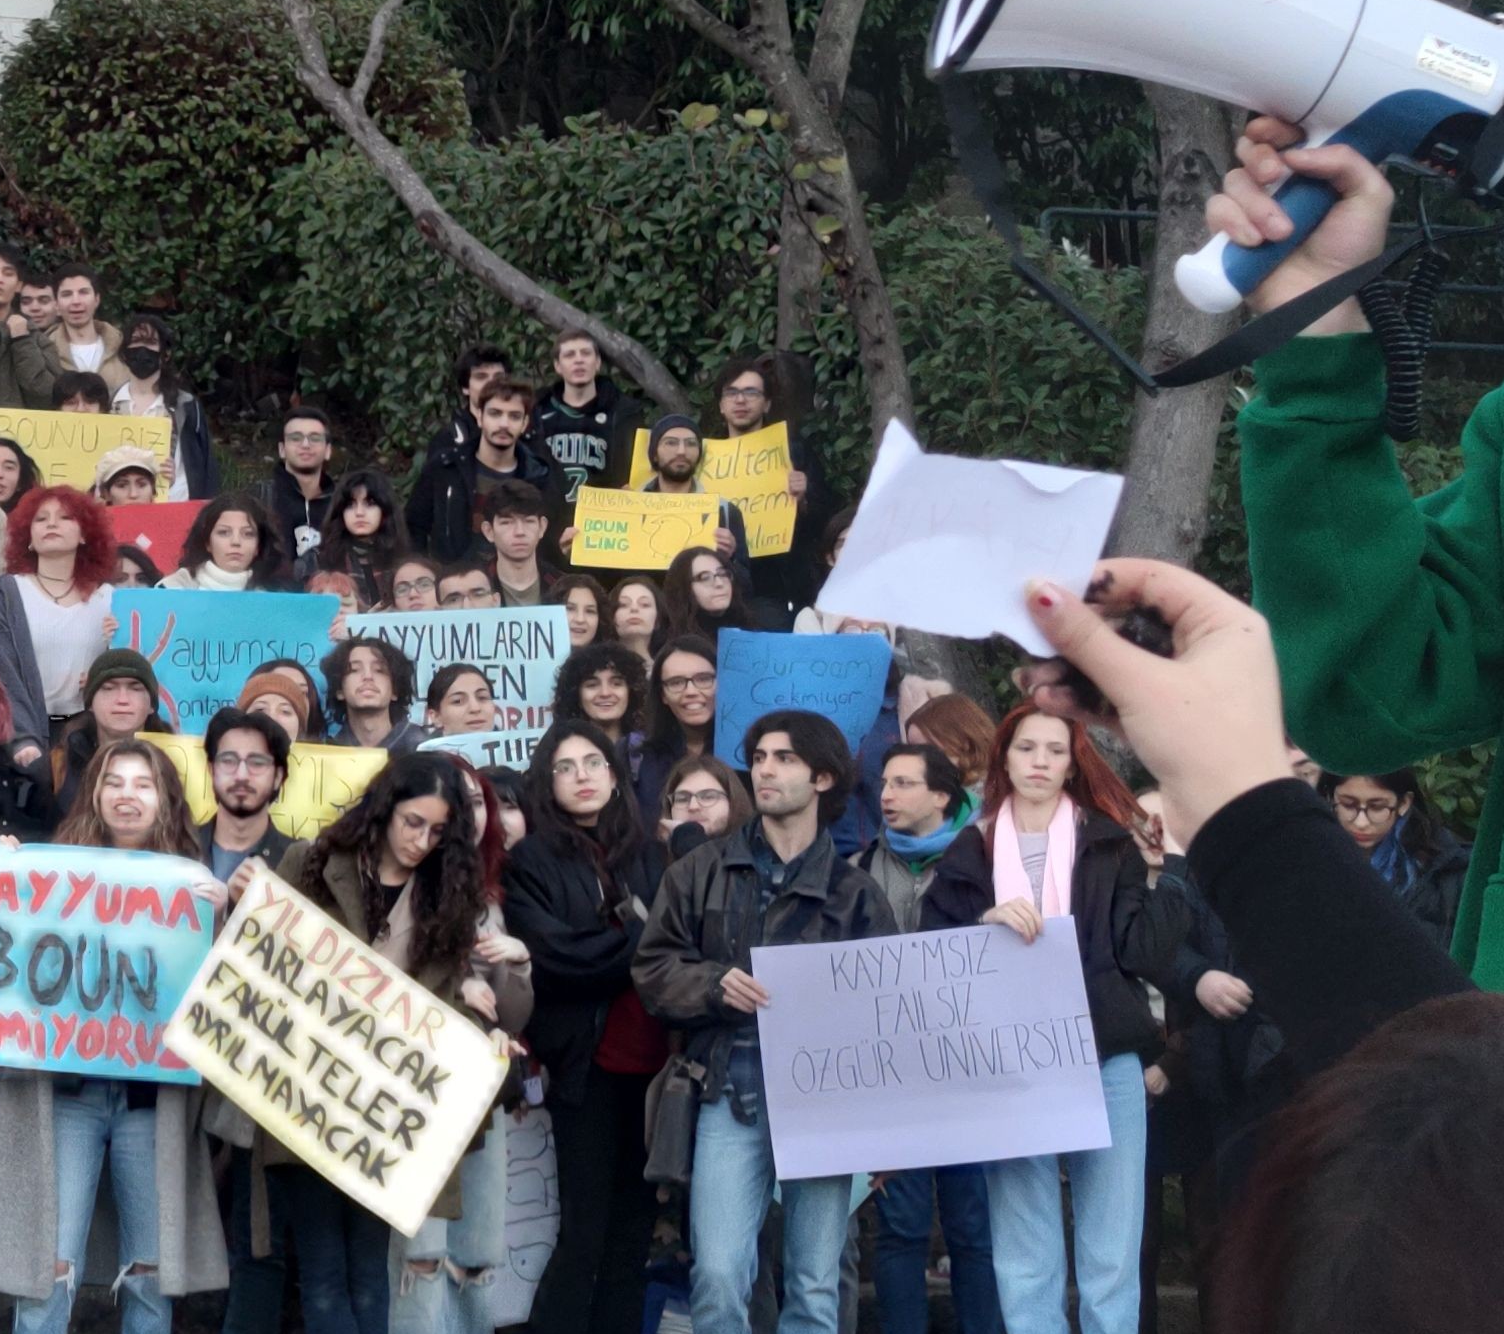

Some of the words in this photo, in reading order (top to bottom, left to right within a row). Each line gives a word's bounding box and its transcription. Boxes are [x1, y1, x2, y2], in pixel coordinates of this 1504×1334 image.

[563, 467, 589, 503] 7
[583, 519, 629, 534] BOUN
[233, 917, 452, 1106] PARLAYACAK
[252, 882, 446, 1051] YILDIZLAR
[183, 1000, 401, 1189] AYRILMAYACAK
[791, 1039, 903, 1095] ÖZGÜR
